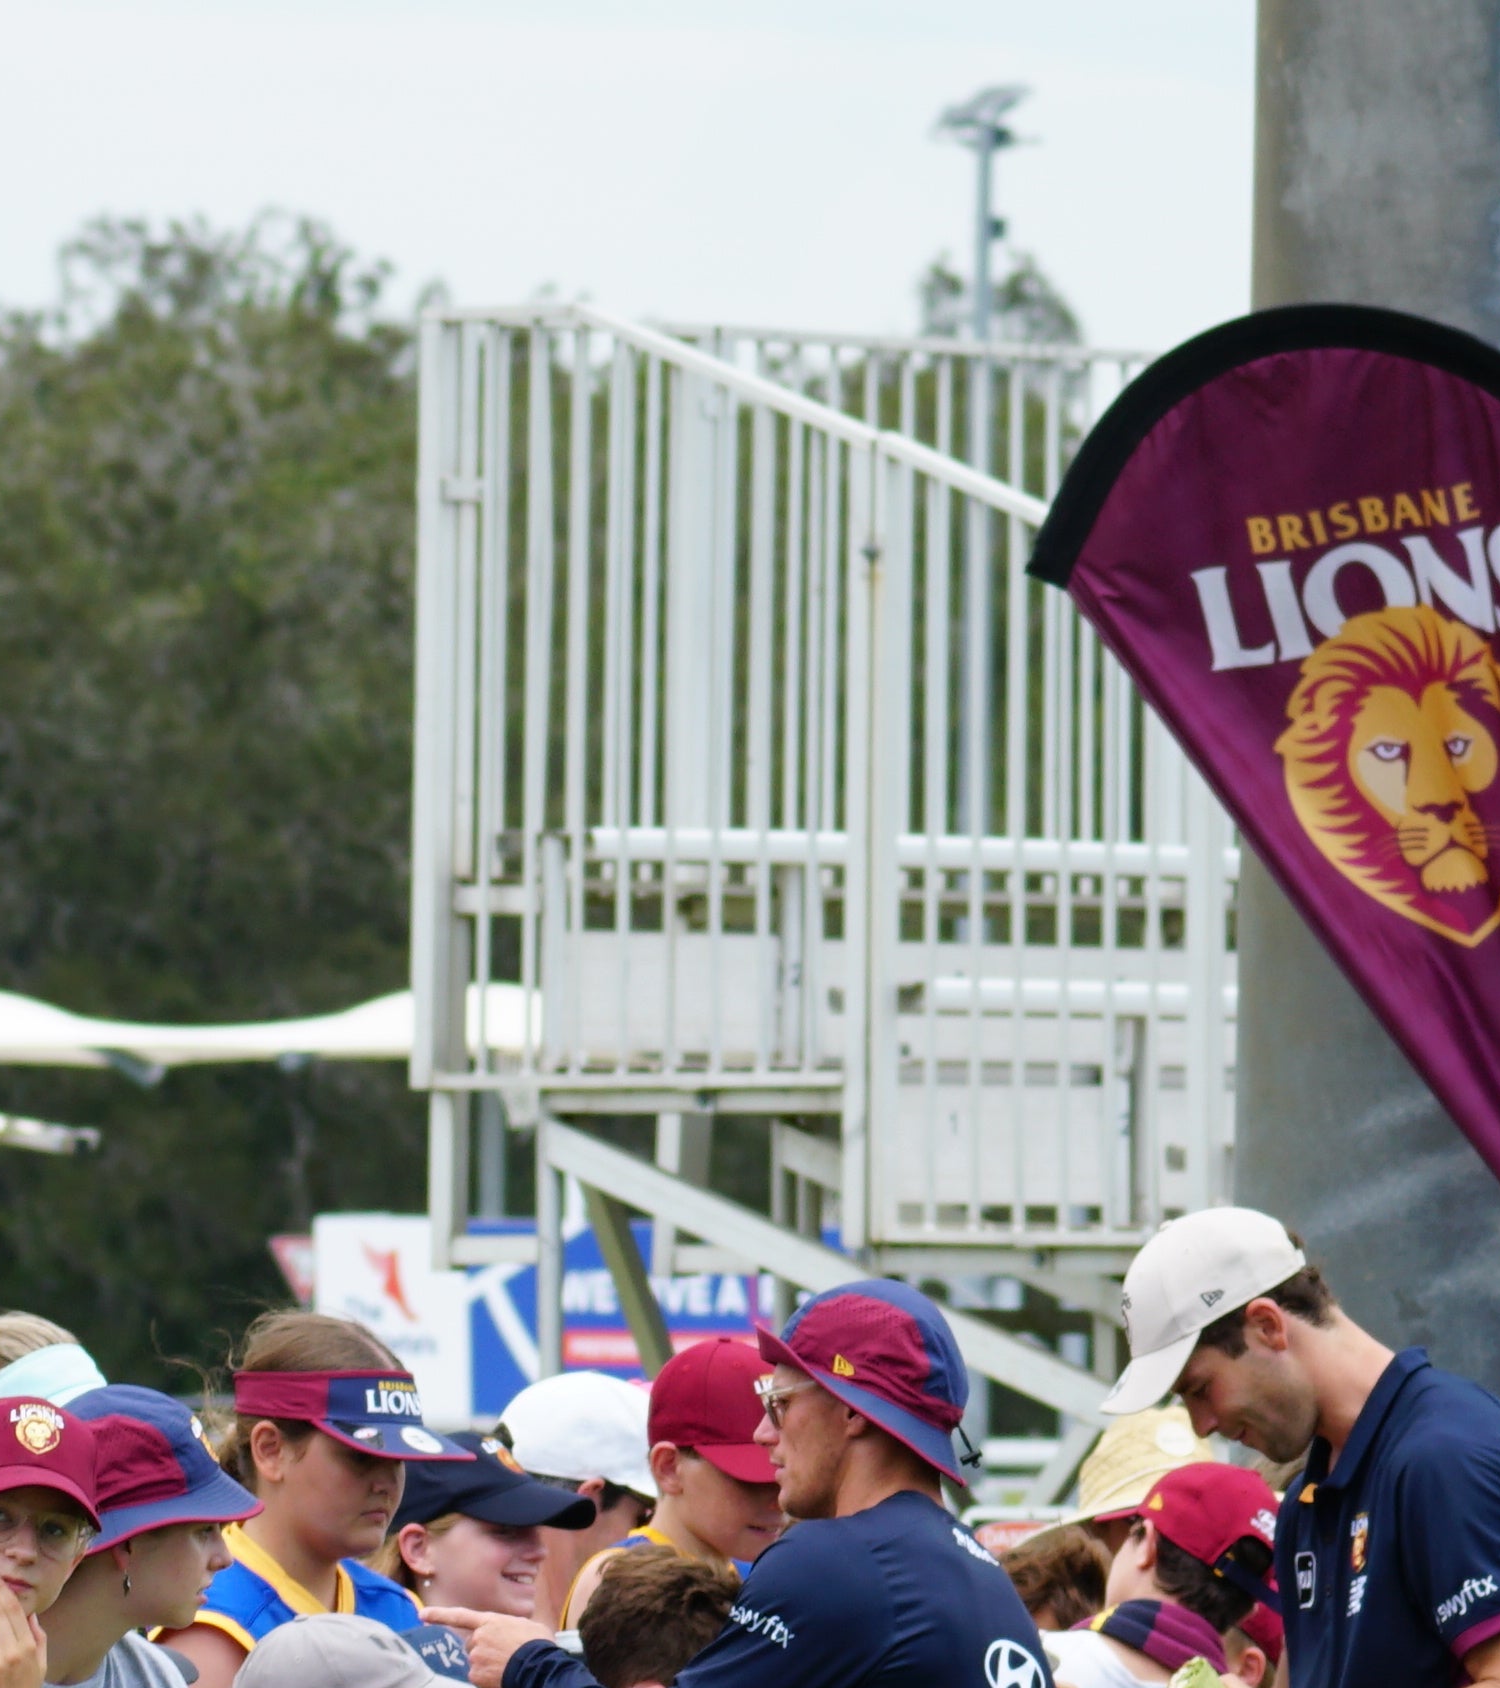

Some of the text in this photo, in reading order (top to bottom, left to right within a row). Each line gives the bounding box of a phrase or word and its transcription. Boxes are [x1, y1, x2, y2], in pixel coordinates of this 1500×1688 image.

[1247, 483, 1480, 554] BRISBANE
[365, 1389, 422, 1417] LION
[1437, 1573, 1499, 1625] swyftx
